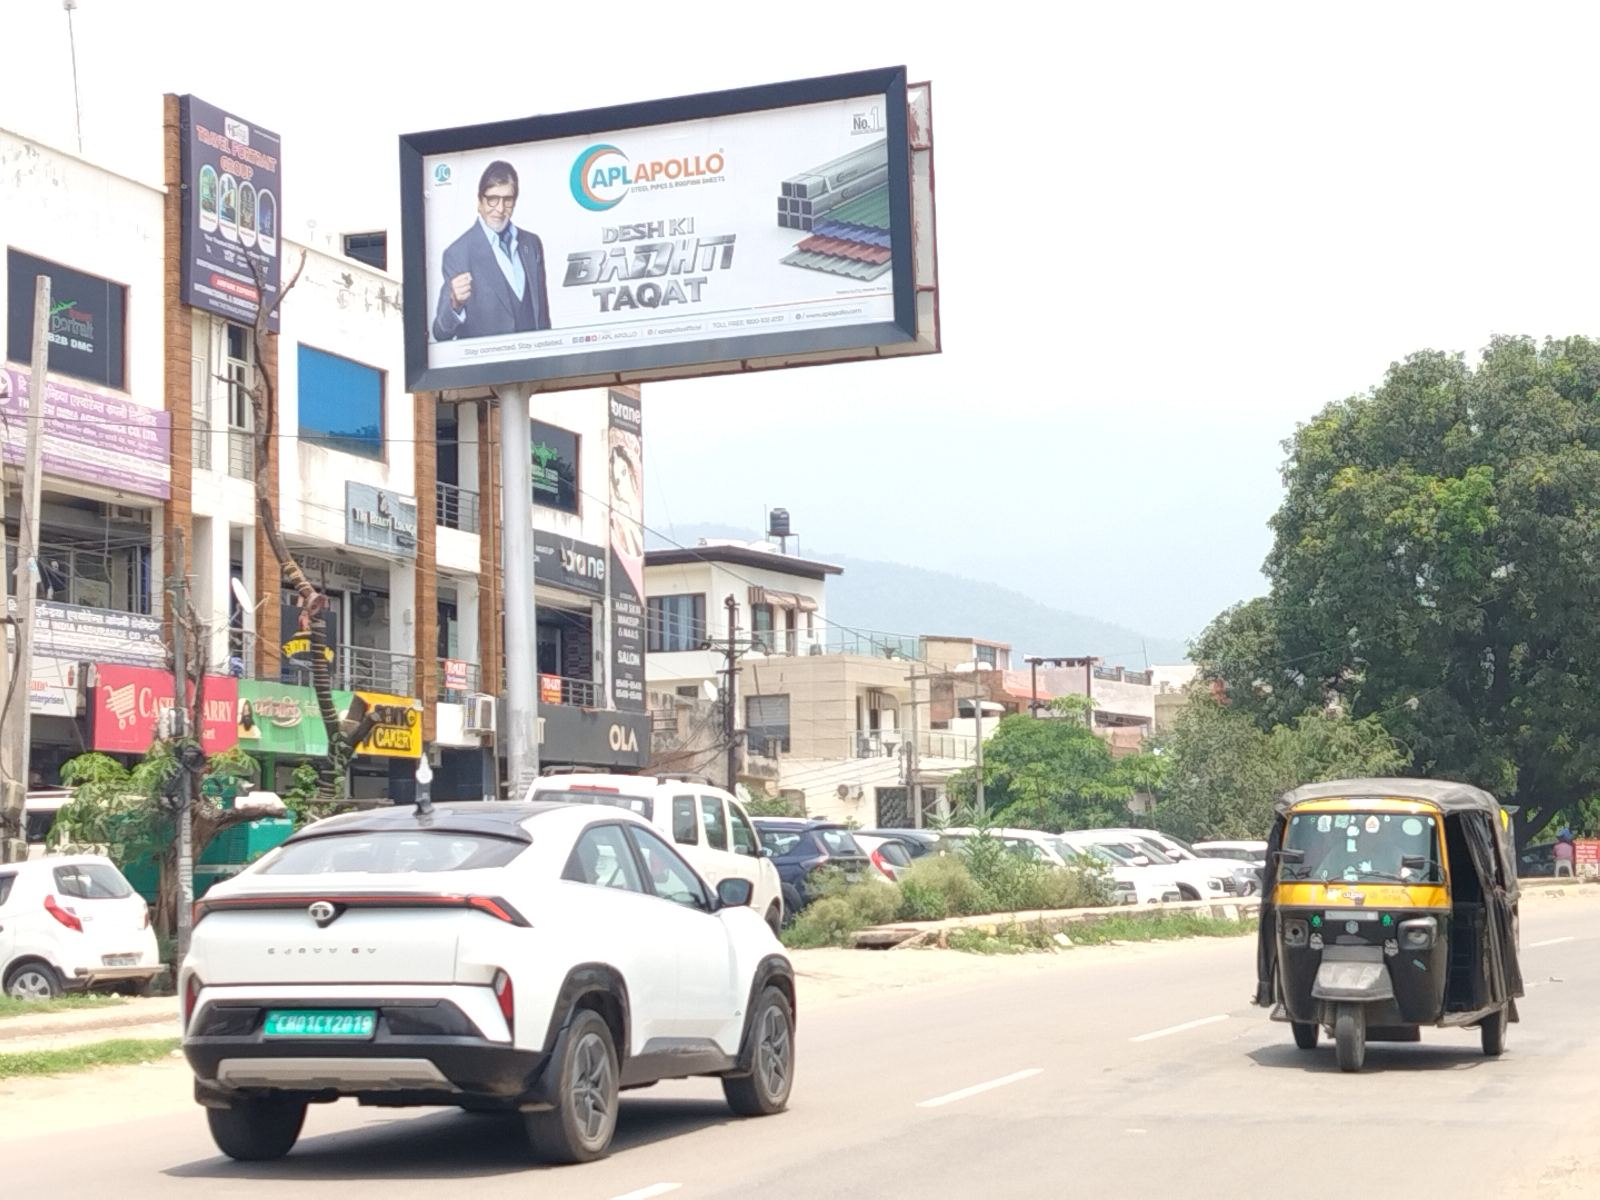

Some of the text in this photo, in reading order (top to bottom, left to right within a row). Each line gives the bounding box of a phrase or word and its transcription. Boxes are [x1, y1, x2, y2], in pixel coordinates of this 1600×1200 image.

[601, 216, 695, 245] DESH KI
[592, 276, 708, 313] TAQAT
[70, 338, 94, 353] DMC
[617, 649, 641, 667] SALON
[609, 724, 639, 753] OLA
